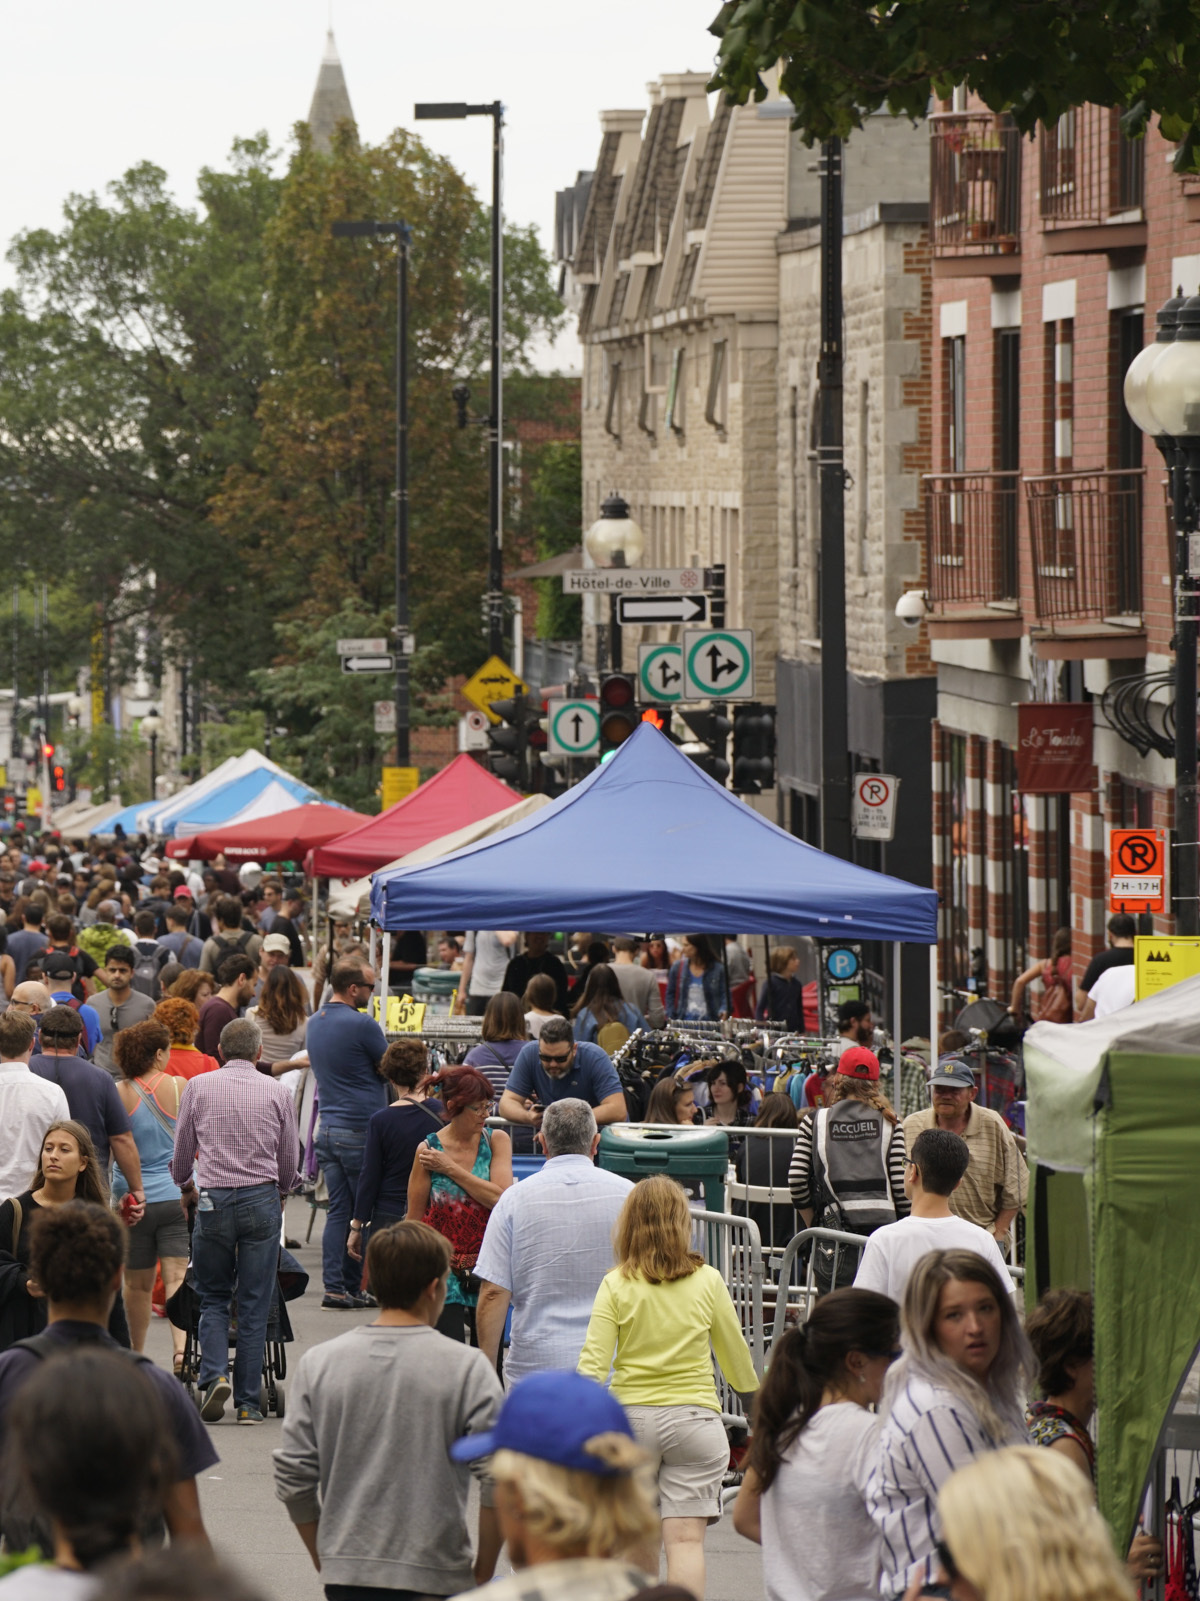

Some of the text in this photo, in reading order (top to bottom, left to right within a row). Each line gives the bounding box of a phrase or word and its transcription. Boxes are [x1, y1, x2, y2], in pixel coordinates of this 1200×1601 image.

[571, 576, 671, 589] Hôtel-de-Ville
[1113, 882, 1120, 890] 7
[1121, 882, 1129, 890] H
[1137, 882, 1149, 891] 17
[1151, 882, 1159, 891] H
[832, 1121, 877, 1134] ACCUEIL
